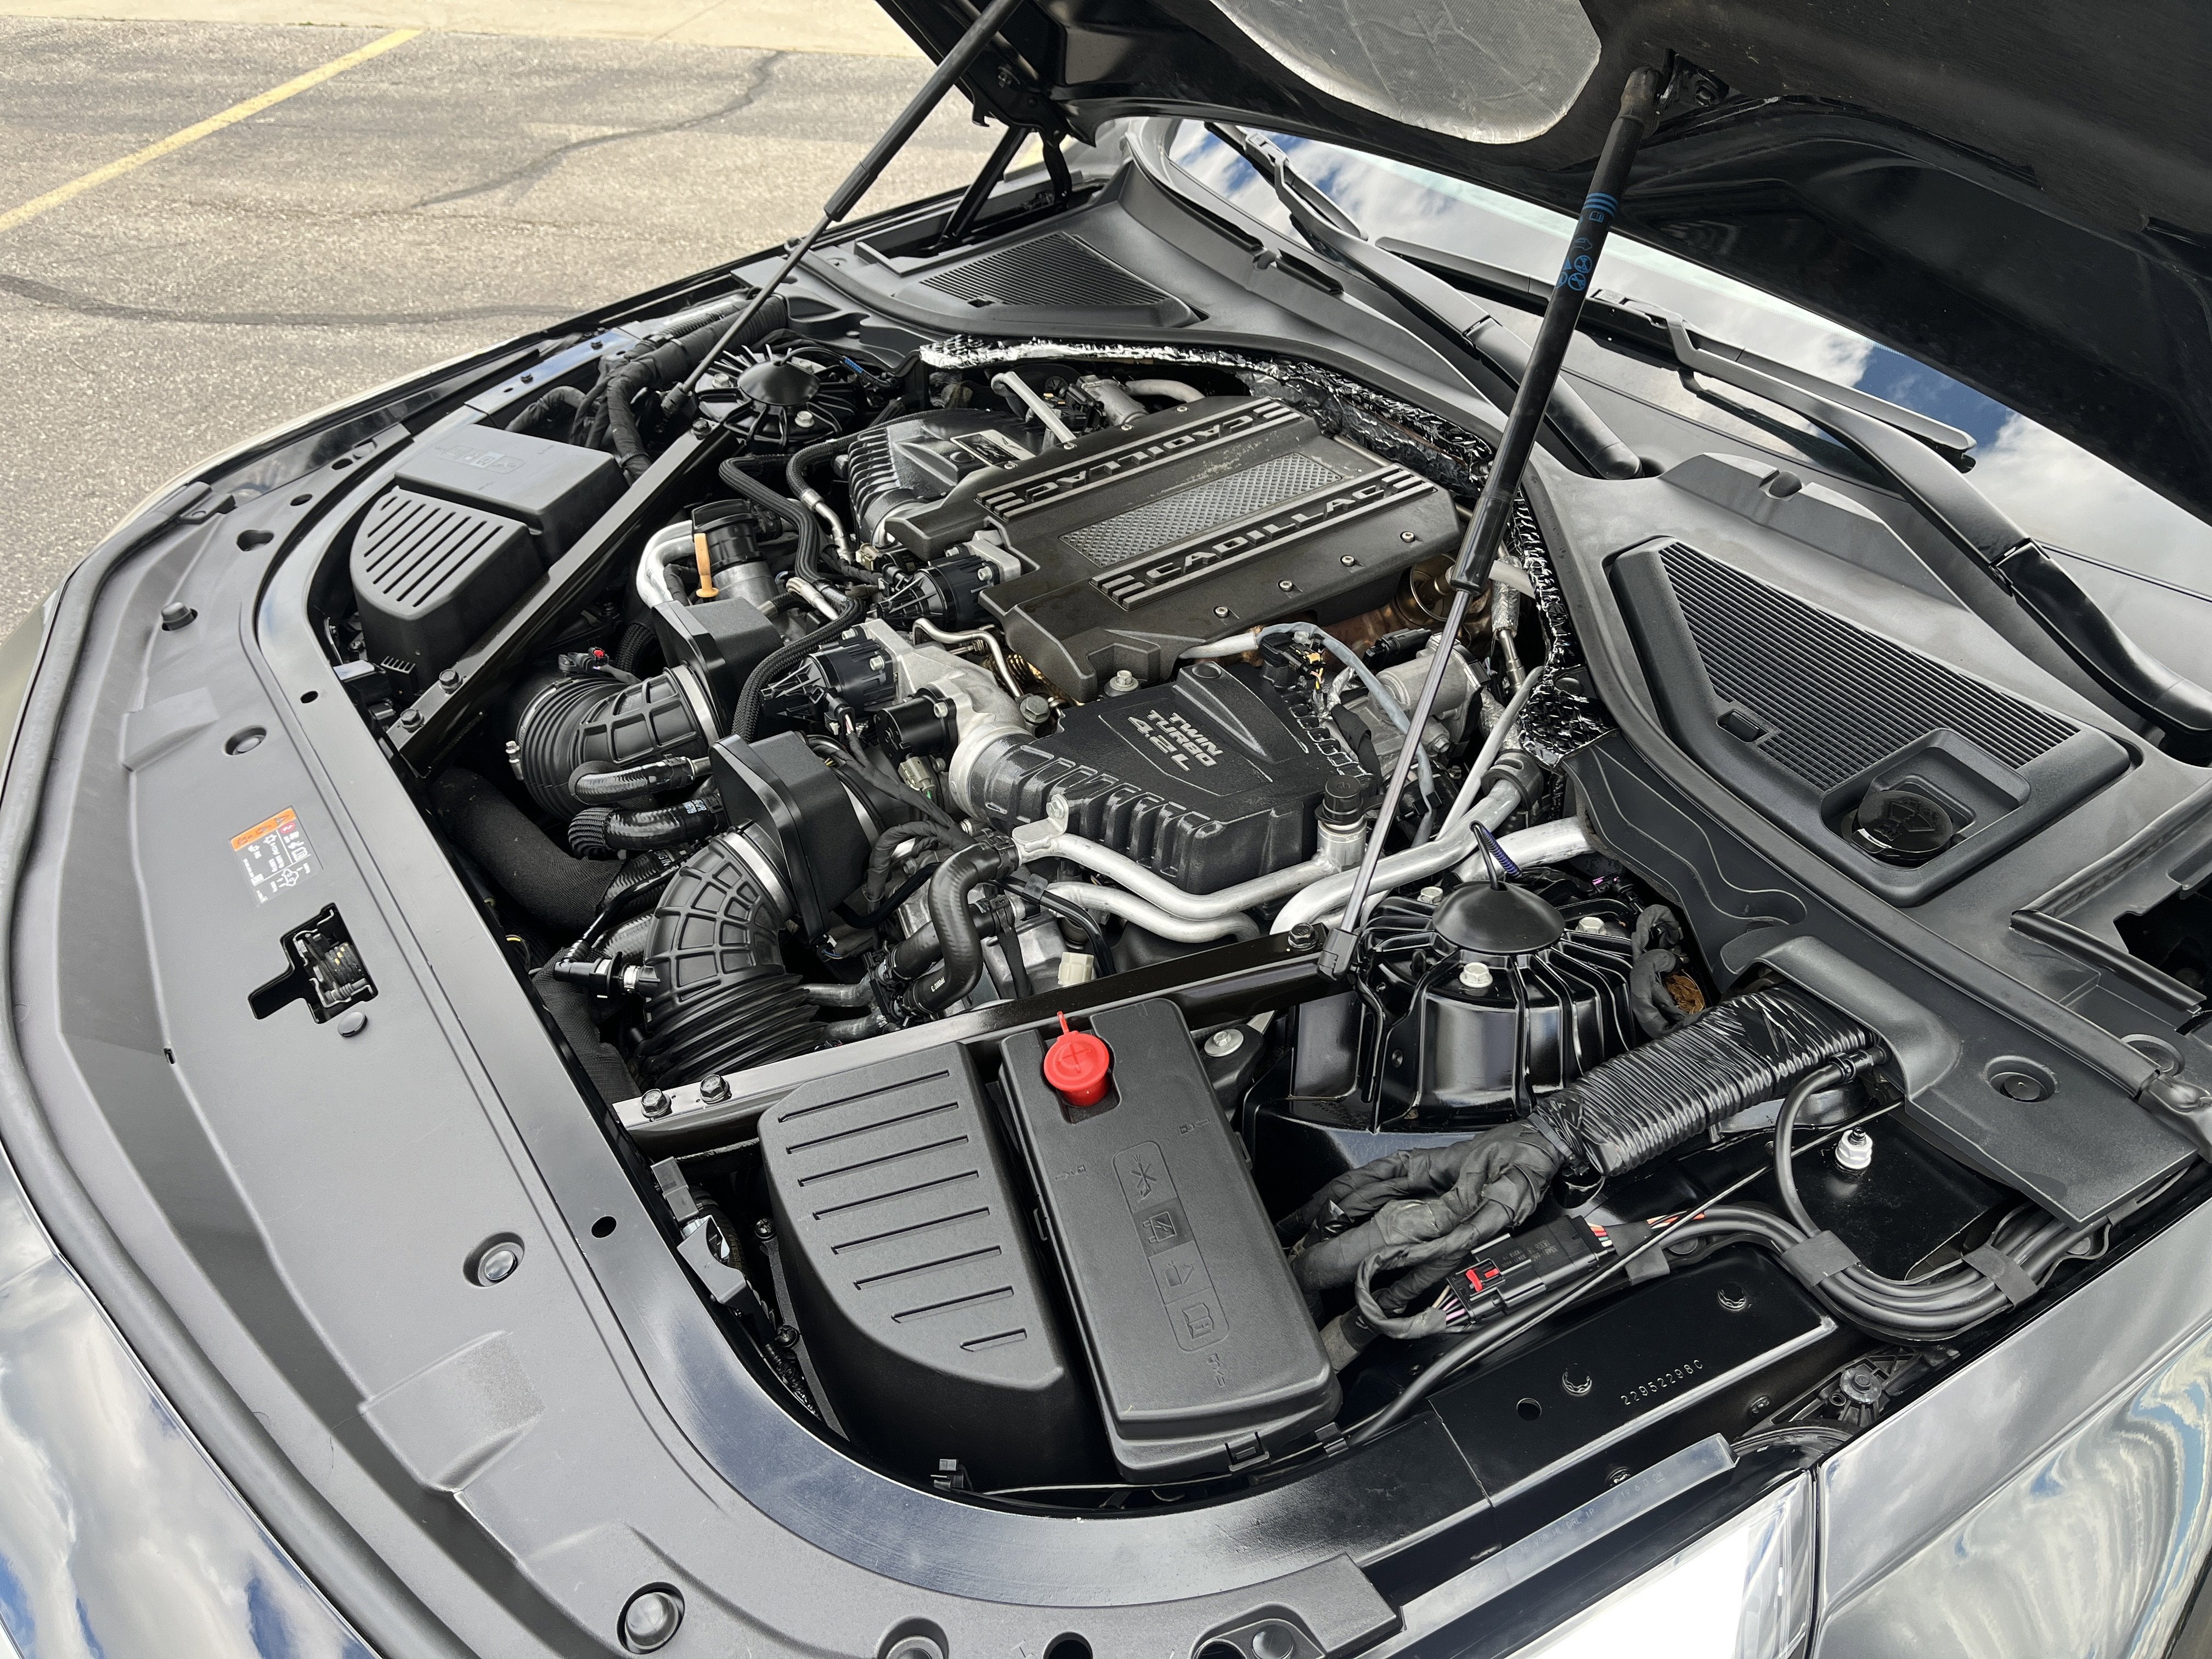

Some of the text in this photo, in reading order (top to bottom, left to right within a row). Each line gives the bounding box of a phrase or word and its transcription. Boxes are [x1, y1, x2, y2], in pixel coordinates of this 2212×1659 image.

[1025, 415, 1253, 503] CADILLAC
[1145, 485, 1385, 584] CADILLAC
[1147, 709, 1217, 767] TURBO
[1169, 712, 1223, 756] TWIN
[1620, 1359, 1703, 1405] 22952298C
[1566, 1517, 1582, 1529] DRL
